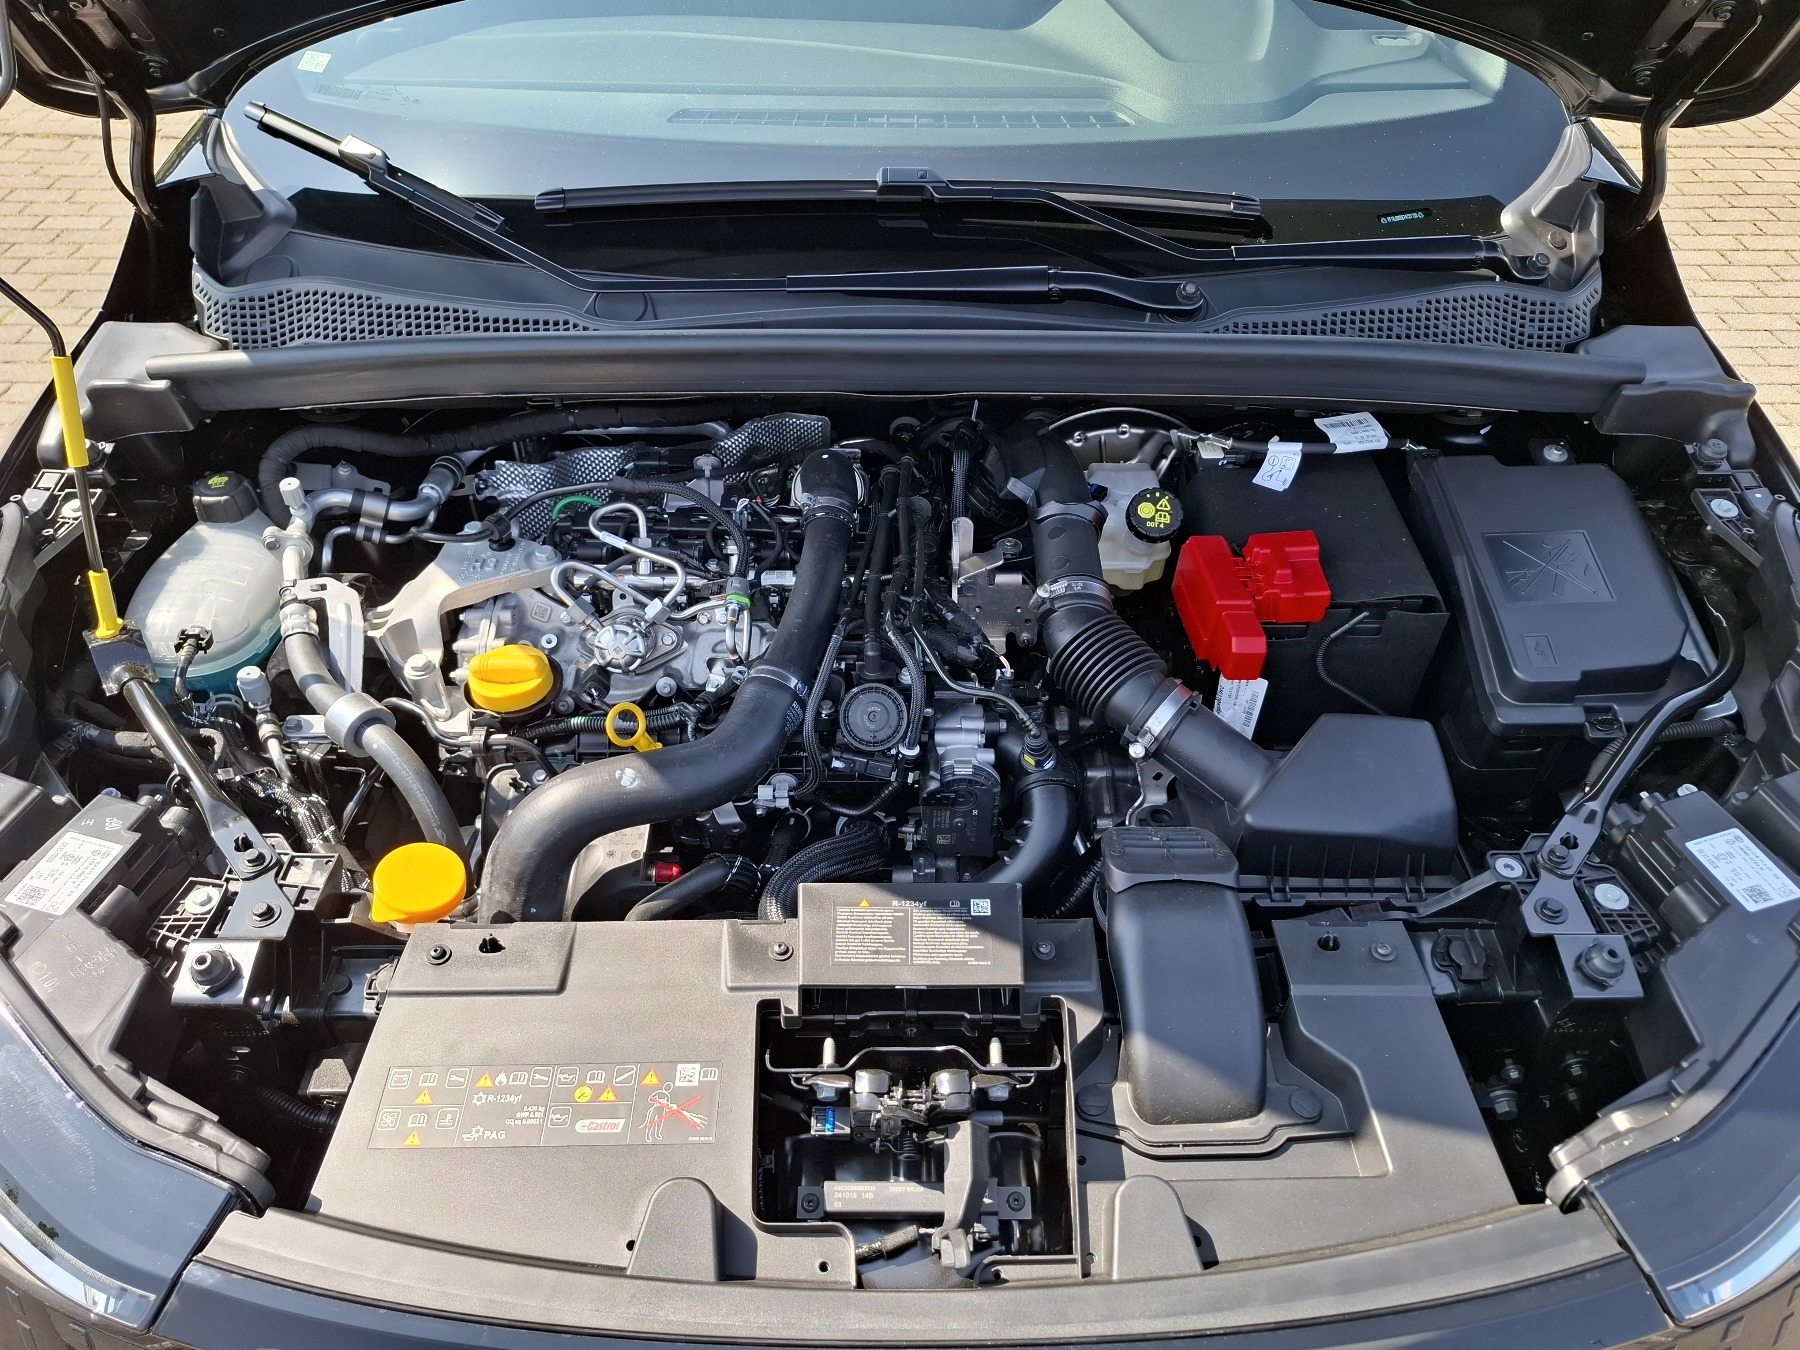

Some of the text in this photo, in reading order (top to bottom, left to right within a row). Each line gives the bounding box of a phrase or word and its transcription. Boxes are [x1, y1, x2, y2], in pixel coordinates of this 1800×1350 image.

[487, 1094, 523, 1104] R-1234yf
[587, 1121, 620, 1131] Castrol
[484, 1131, 506, 1139] PAG
